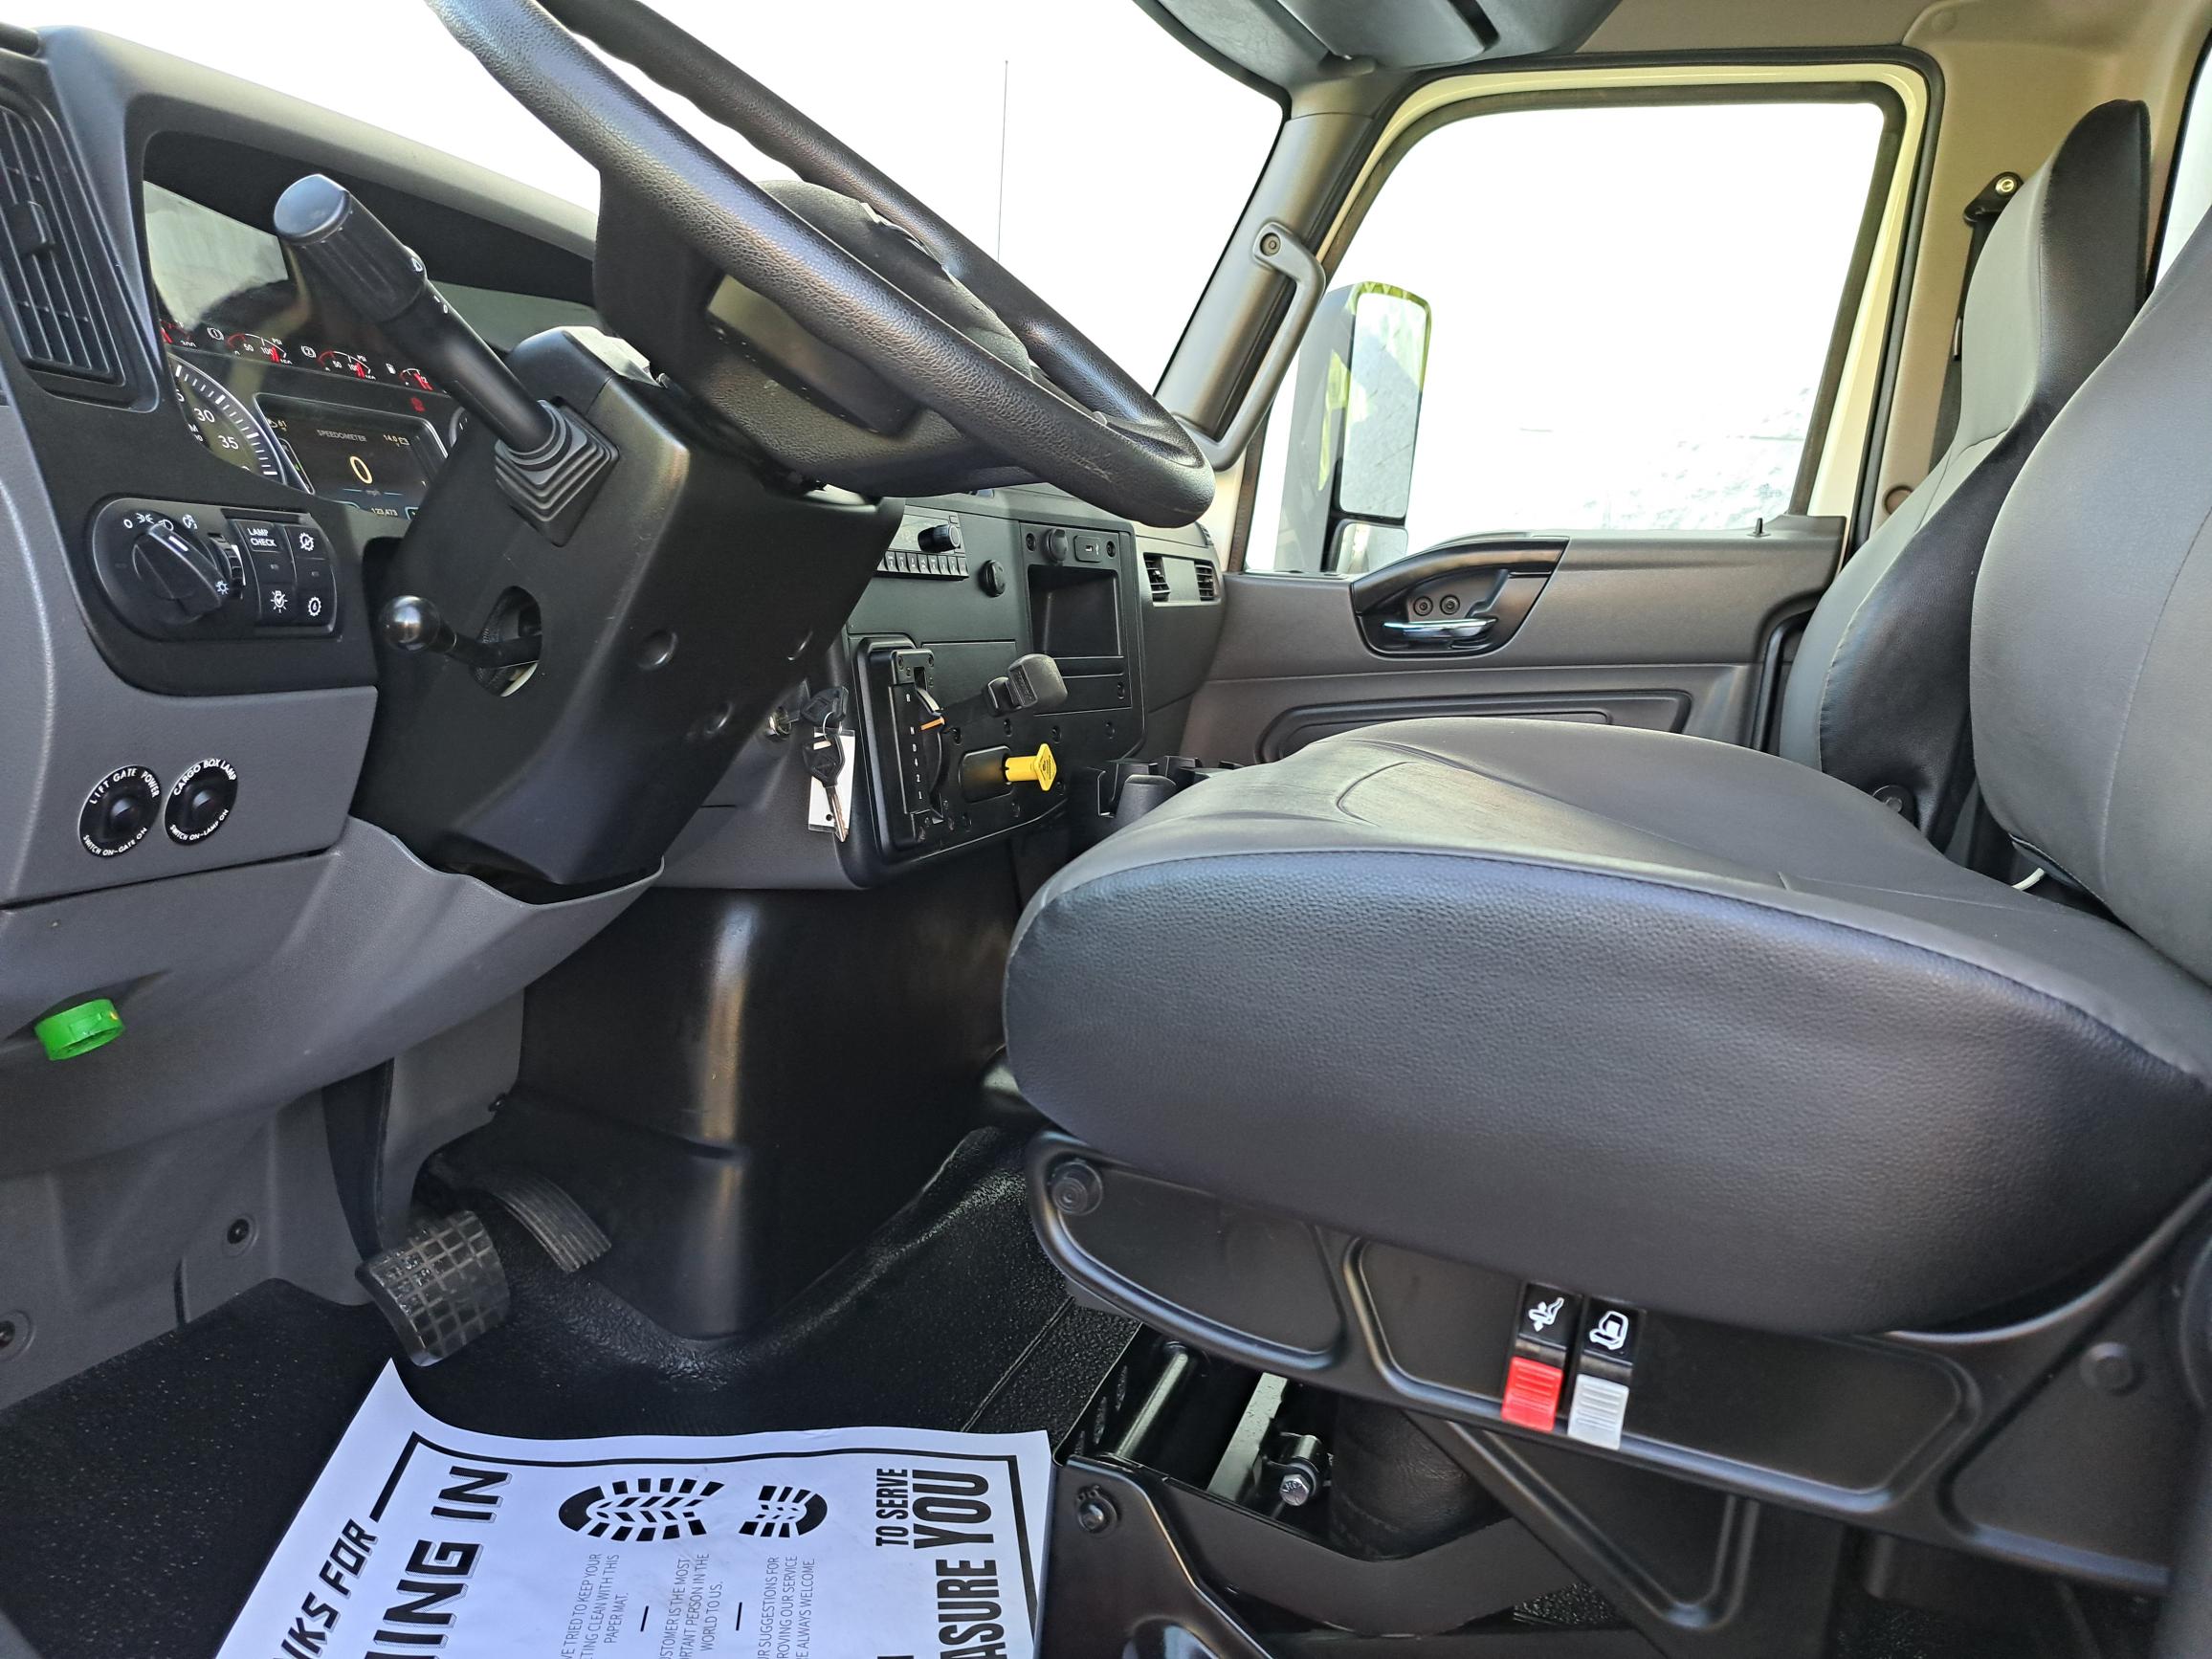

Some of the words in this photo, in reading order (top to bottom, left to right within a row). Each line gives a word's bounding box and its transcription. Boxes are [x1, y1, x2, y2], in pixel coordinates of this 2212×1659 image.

[243, 343, 254, 352] 50
[332, 360, 343, 368] 50
[193, 408, 215, 423] 30
[217, 434, 239, 450] 35
[317, 429, 367, 442] SPEEDOMETER
[349, 455, 373, 484] 0
[247, 528, 269, 537] LAMP
[250, 538, 277, 548] CHECK
[89, 780, 110, 805] LIFT
[113, 767, 138, 783] GATE
[141, 770, 161, 798] POWER
[173, 765, 201, 796] CARGO
[203, 759, 220, 769] BOX
[221, 760, 237, 781] LAMP
[169, 824, 188, 841] SWITCH
[219, 808, 230, 821] ON
[82, 834, 102, 855] SWITCH
[136, 827, 148, 840] ON
[874, 1468, 909, 1520] SERVE
[912, 1469, 994, 1549] YOU
[874, 1525, 909, 1547] TO
[319, 1518, 378, 1599] FOR
[364, 1538, 484, 1659] ING
[431, 1466, 513, 1523] IN
[585, 1554, 603, 1579] YOUR
[603, 1554, 620, 1575] THIS
[695, 1553, 710, 1571] THE
[765, 1557, 780, 1575] FOR
[674, 1558, 690, 1585] MOST
[692, 1573, 706, 1584] IN
[782, 1556, 798, 1593] SERVICE
[577, 1580, 593, 1603] KEEP
[597, 1577, 613, 1602] WITH
[671, 1587, 685, 1606] THE
[572, 1604, 588, 1617] TO
[587, 1603, 606, 1631] CLEAN
[668, 1607, 681, 1617] IS
[684, 1586, 704, 1626] PERSON
[705, 1600, 719, 1614] TO
[758, 1576, 778, 1647] SUGGESTIONS
[780, 1595, 794, 1617] OUR
[563, 1618, 584, 1647] TRIED
[604, 1614, 623, 1644] PAPER
[699, 1616, 718, 1651] WORLD
[796, 1609, 811, 1649] ALWAYS
[579, 1633, 599, 1659] TING
[678, 1627, 697, 1659] RTANT
